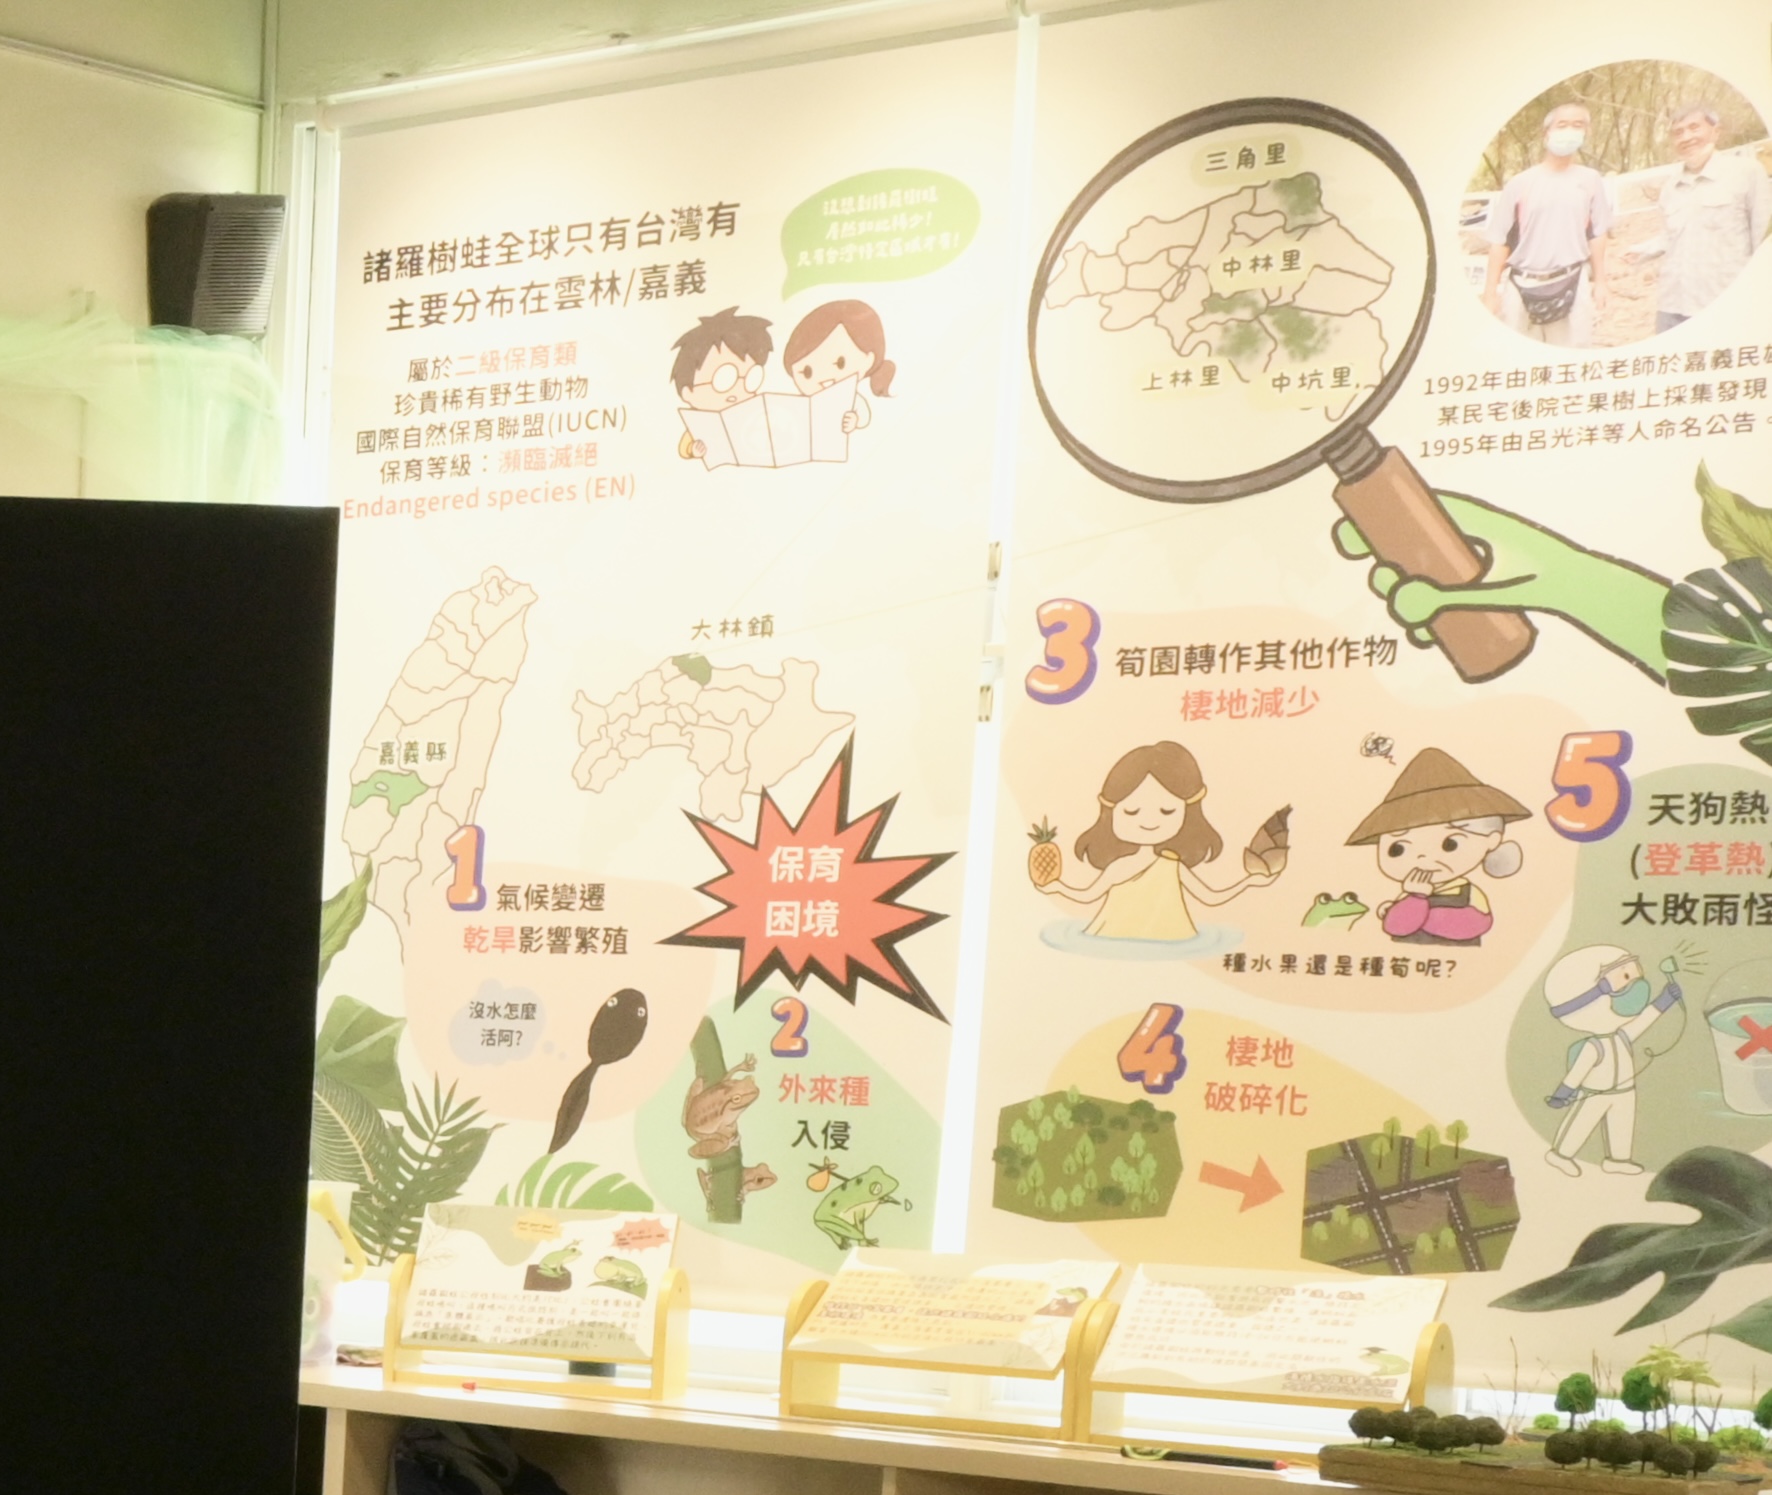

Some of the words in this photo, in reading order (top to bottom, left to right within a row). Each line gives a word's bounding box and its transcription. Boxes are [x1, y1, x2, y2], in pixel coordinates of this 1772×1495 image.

[1203, 143, 1287, 173] 三角里
[362, 200, 742, 284] 諸羅樹蛙全球只有台灣有
[1220, 249, 1303, 279] 中林里
[385, 259, 707, 331] 主要分布在雲林/嘉義
[408, 341, 578, 382] 屬於二級保育類
[1141, 363, 1221, 390] 上林里
[1270, 365, 1354, 393] 中坑里
[394, 377, 588, 416] 珍貴稀有野生動物
[1437, 377, 1768, 426] 某民宅後院芒果樹上採集發現
[356, 405, 627, 455] 國際自然保育聯盟(IUCN)
[380, 442, 598, 484] 保育等級：瀕臨滅絕
[344, 487, 479, 519] Endangered
[487, 481, 576, 510] species
[585, 474, 635, 503] (EN)
[689, 614, 775, 641] 大林鎮
[1025, 598, 1101, 705] 3
[1115, 635, 1398, 678] 筍園轉作其他作物
[1180, 686, 1319, 721] 棲地減少
[378, 739, 448, 766] 嘉義縣
[1544, 730, 1633, 843] 5
[1648, 790, 1769, 827] 天狗熱
[445, 825, 487, 911] 1
[767, 846, 842, 884] 保育
[495, 883, 605, 914] 氣候變遷
[764, 900, 839, 939] 困境
[462, 926, 629, 956] 乾旱影響繁殖
[1222, 953, 1456, 979] 種水果還是種筍呢?
[467, 1001, 537, 1022] 沒水怎麼
[770, 998, 809, 1058] 2
[480, 1028, 524, 1049] 活阿?
[1117, 1002, 1185, 1094] 4
[1225, 1035, 1294, 1069] 棲地
[778, 1074, 870, 1106] 外來種
[1203, 1083, 1308, 1117] 破碎化
[792, 1121, 850, 1152] 入侵
